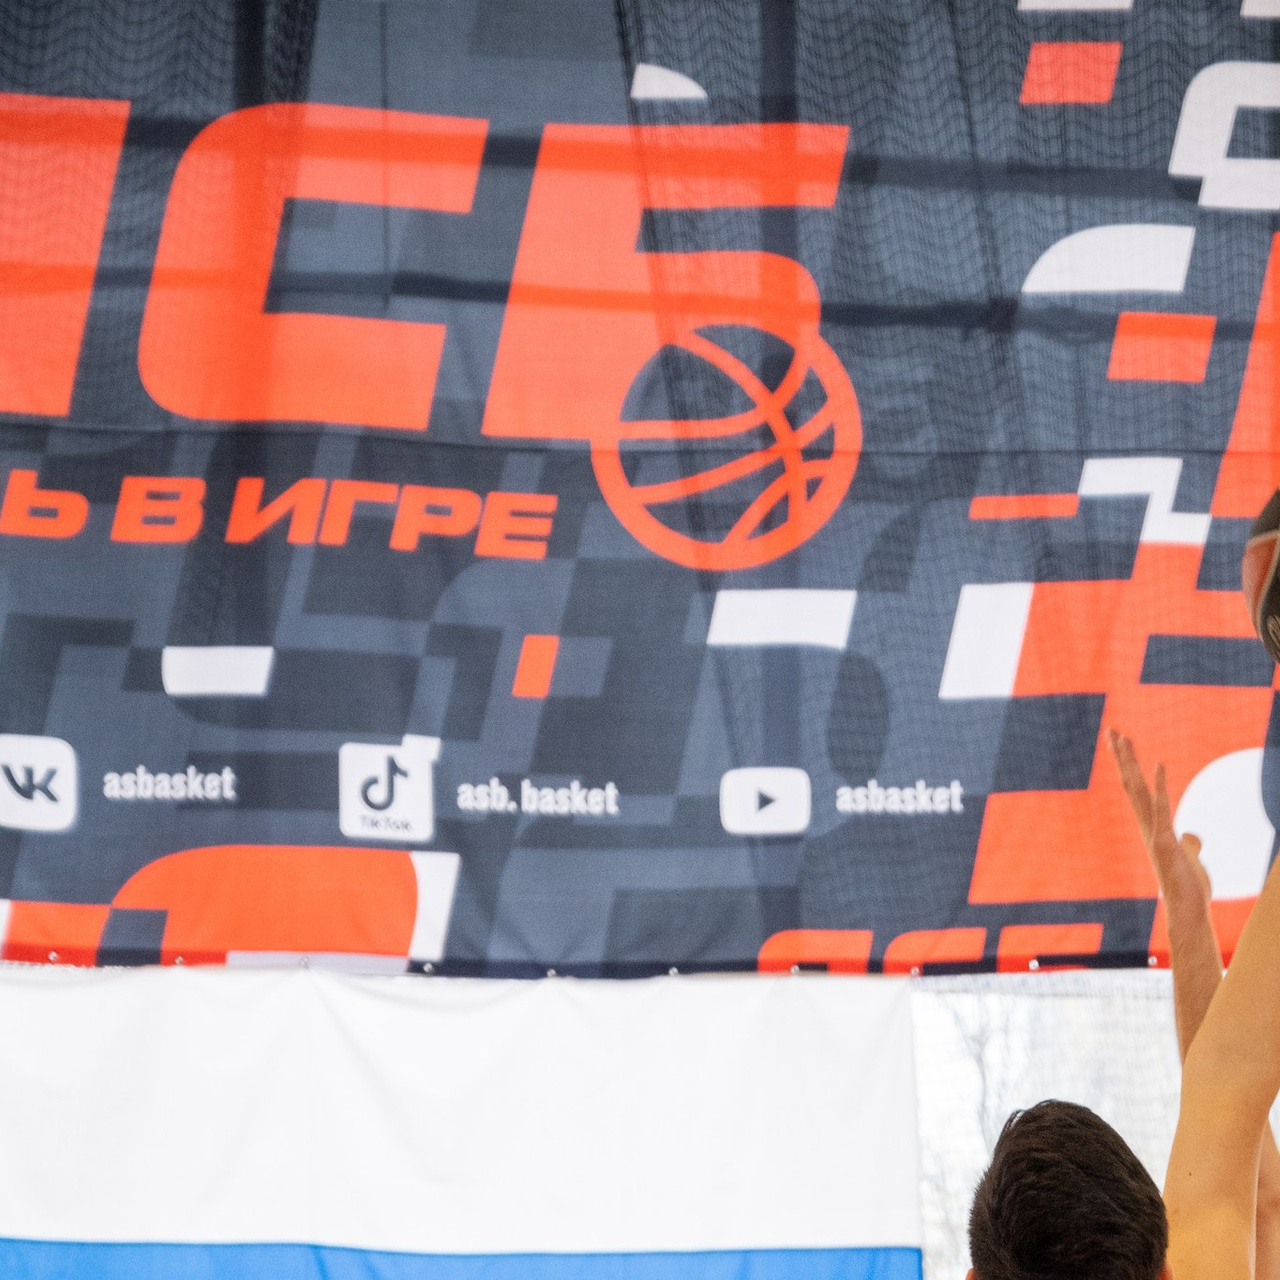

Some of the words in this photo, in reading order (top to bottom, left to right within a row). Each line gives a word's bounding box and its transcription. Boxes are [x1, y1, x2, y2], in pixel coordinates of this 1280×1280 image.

[224, 476, 559, 561] ИГРЕ
[103, 764, 237, 800] asbasket
[835, 778, 964, 814] asbasket
